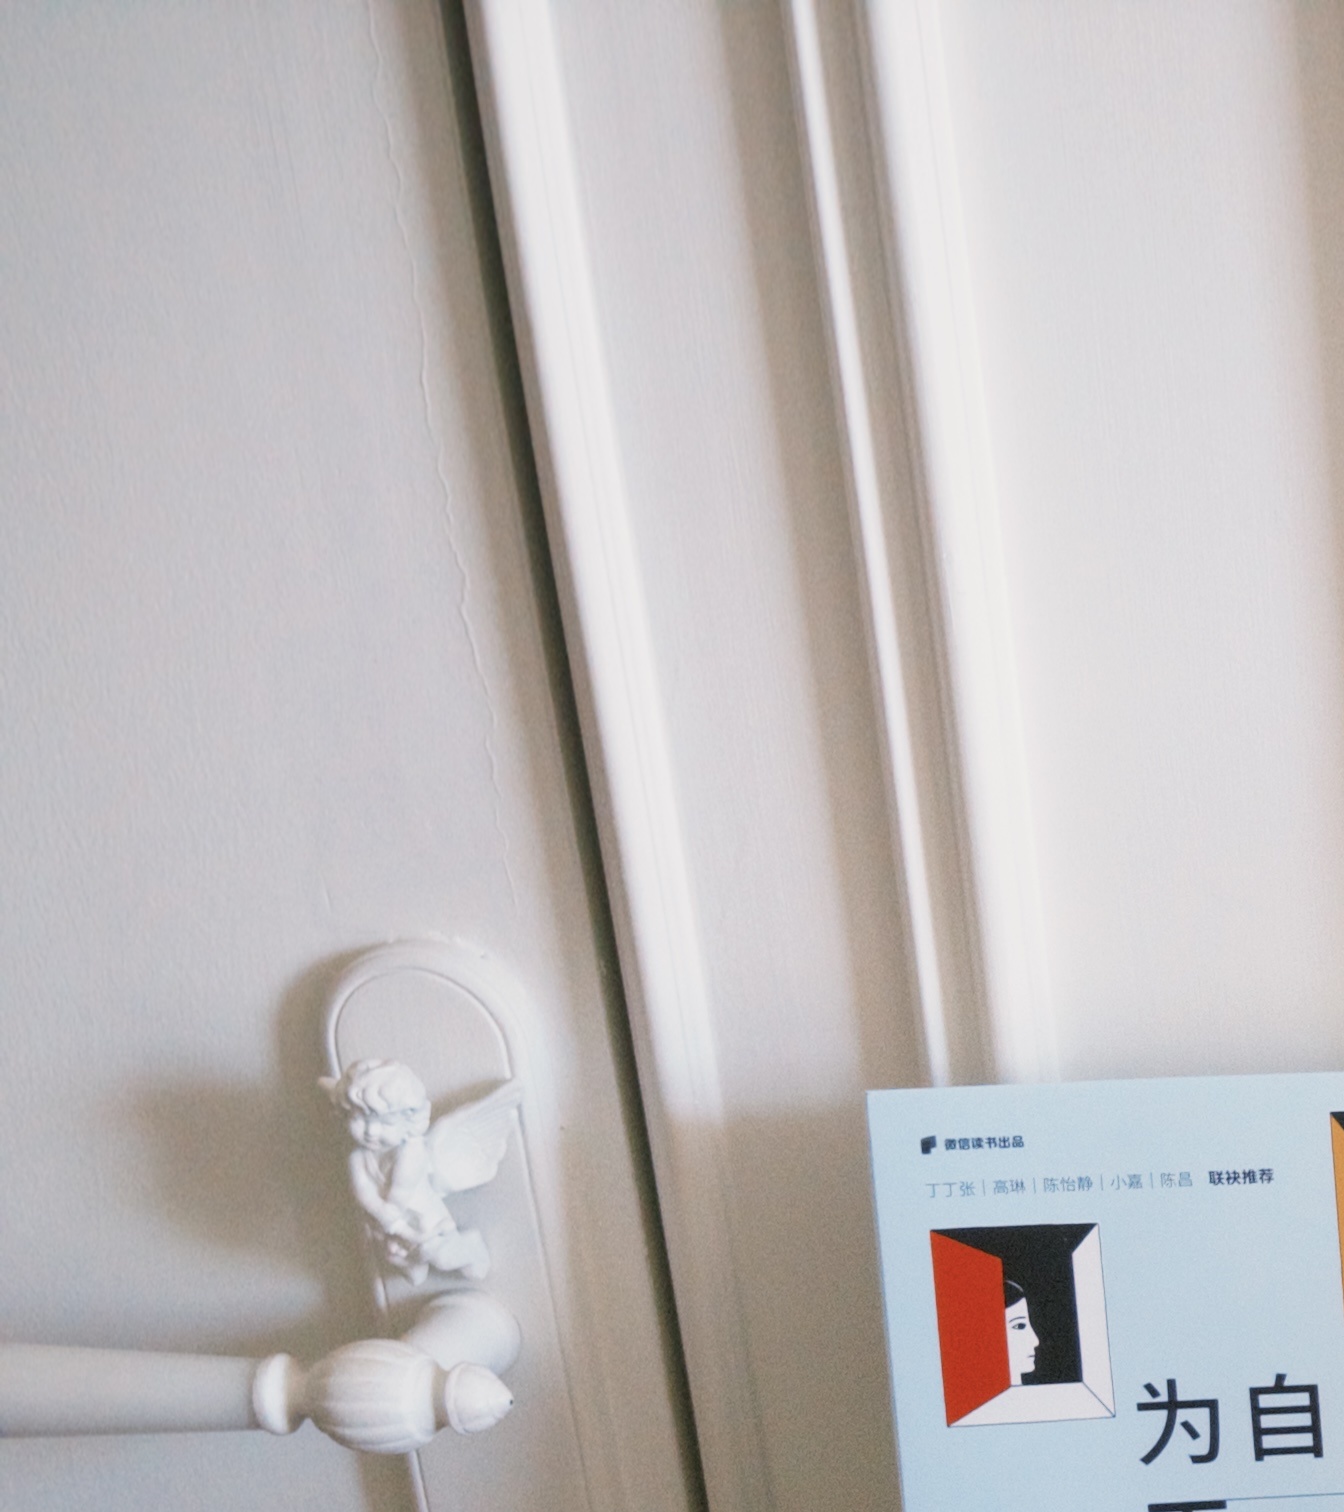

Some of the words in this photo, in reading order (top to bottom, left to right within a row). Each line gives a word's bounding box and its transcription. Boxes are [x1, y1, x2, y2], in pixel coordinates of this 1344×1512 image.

[944, 1135, 1025, 1151] 微信读书出品
[1208, 1168, 1275, 1186] 联袂推荐
